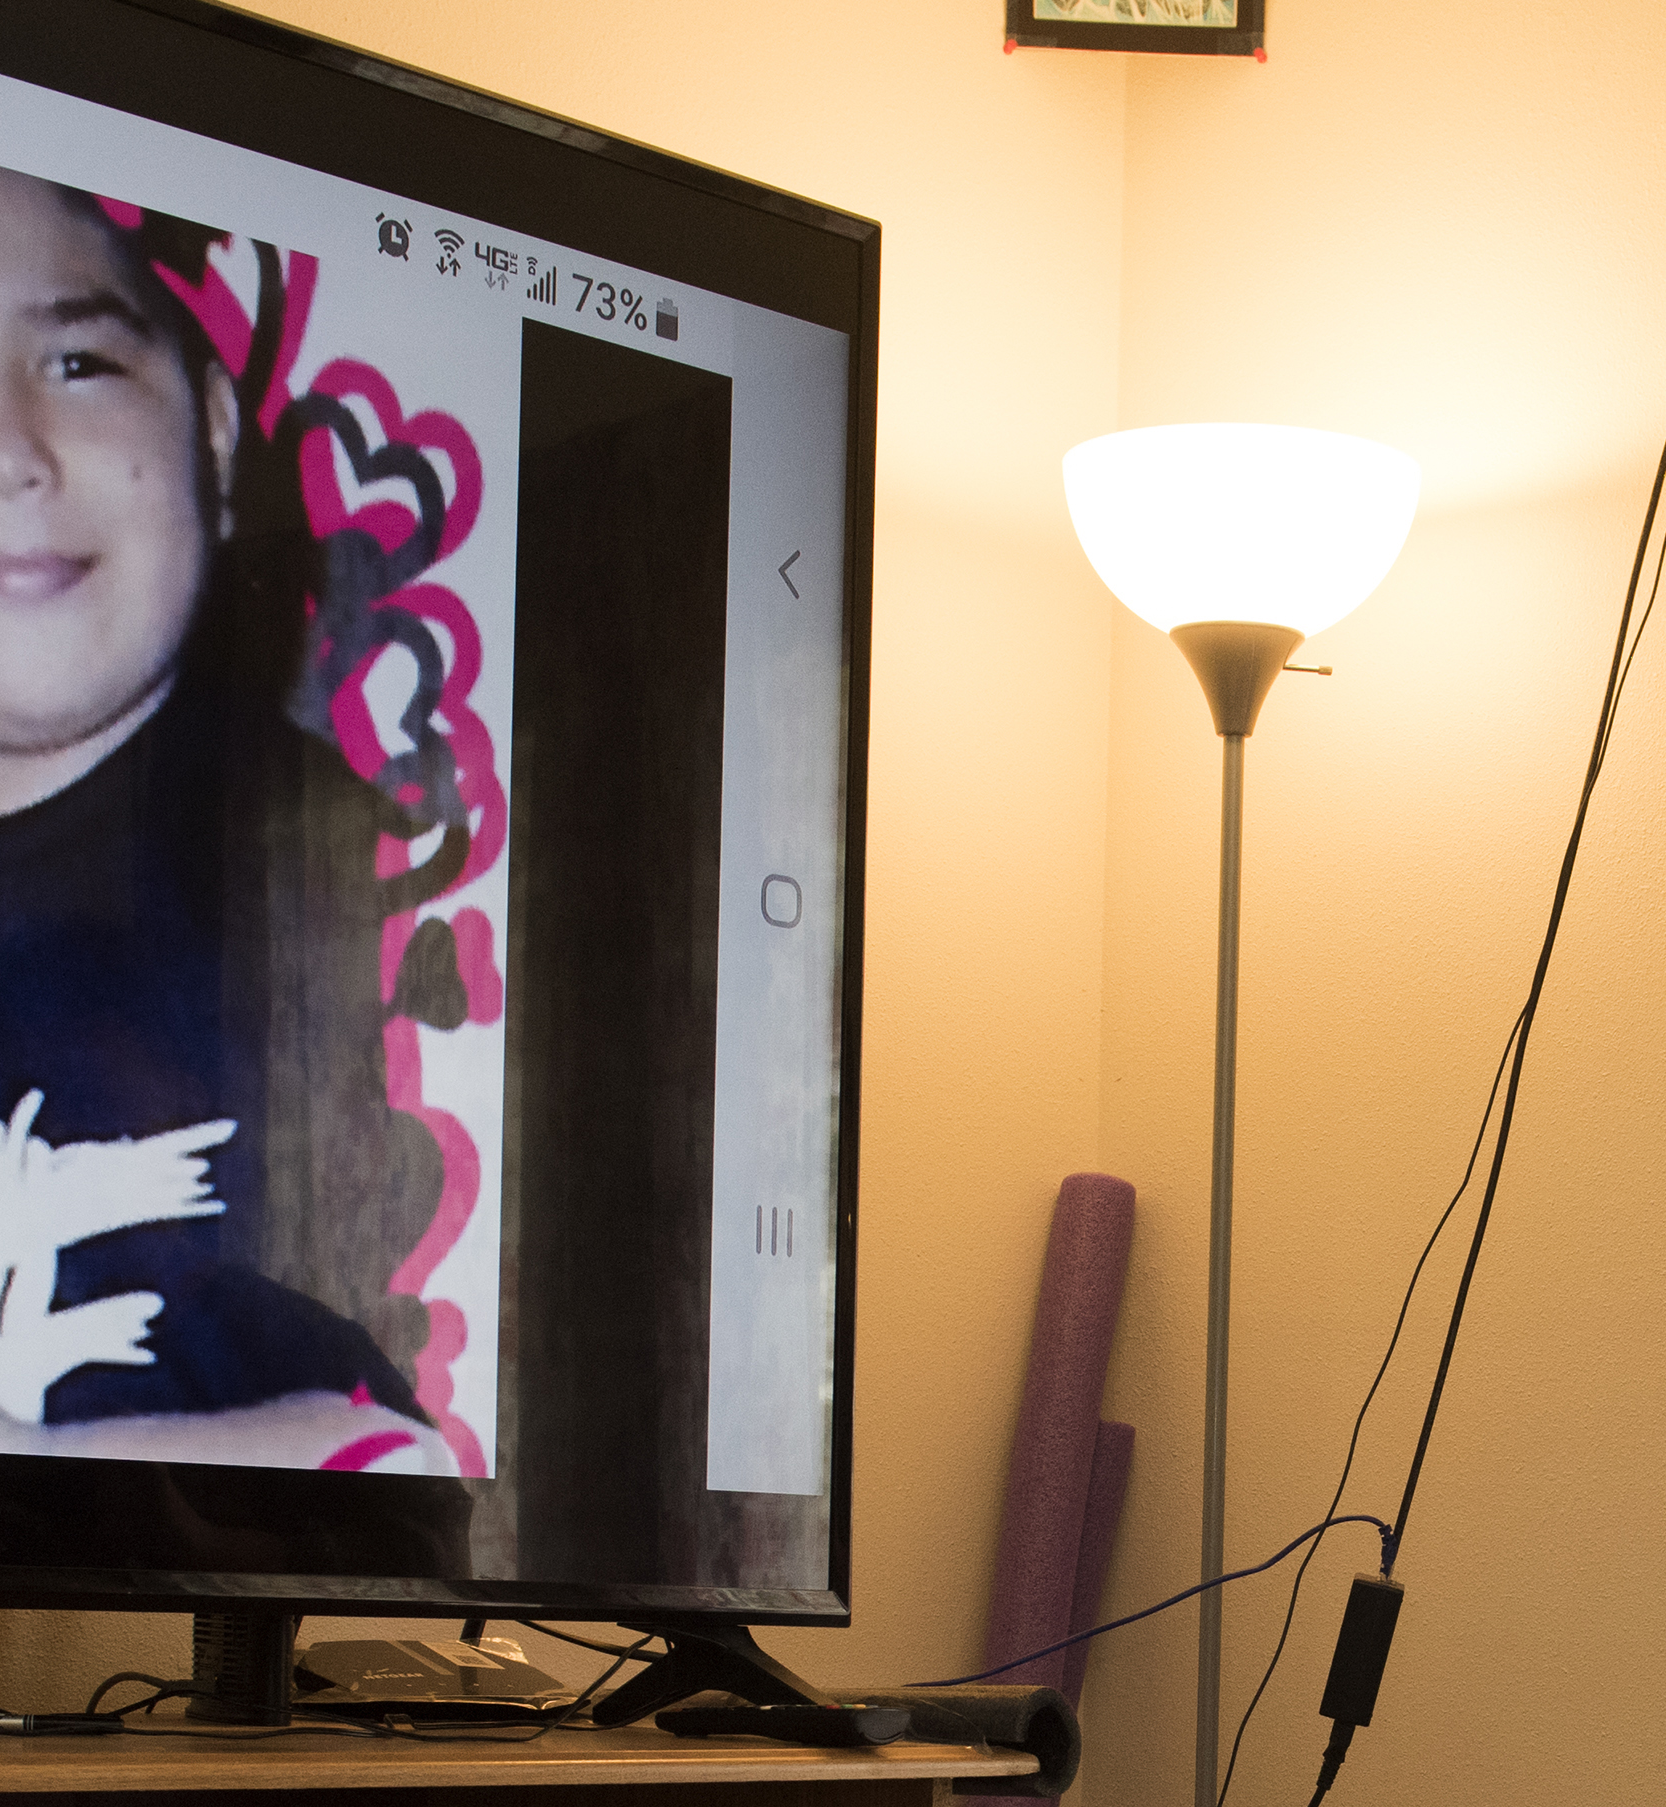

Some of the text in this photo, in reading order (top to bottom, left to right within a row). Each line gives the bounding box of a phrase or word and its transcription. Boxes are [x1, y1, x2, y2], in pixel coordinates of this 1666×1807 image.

[474, 241, 519, 275] 4G LTE
[572, 273, 648, 332] 73%
